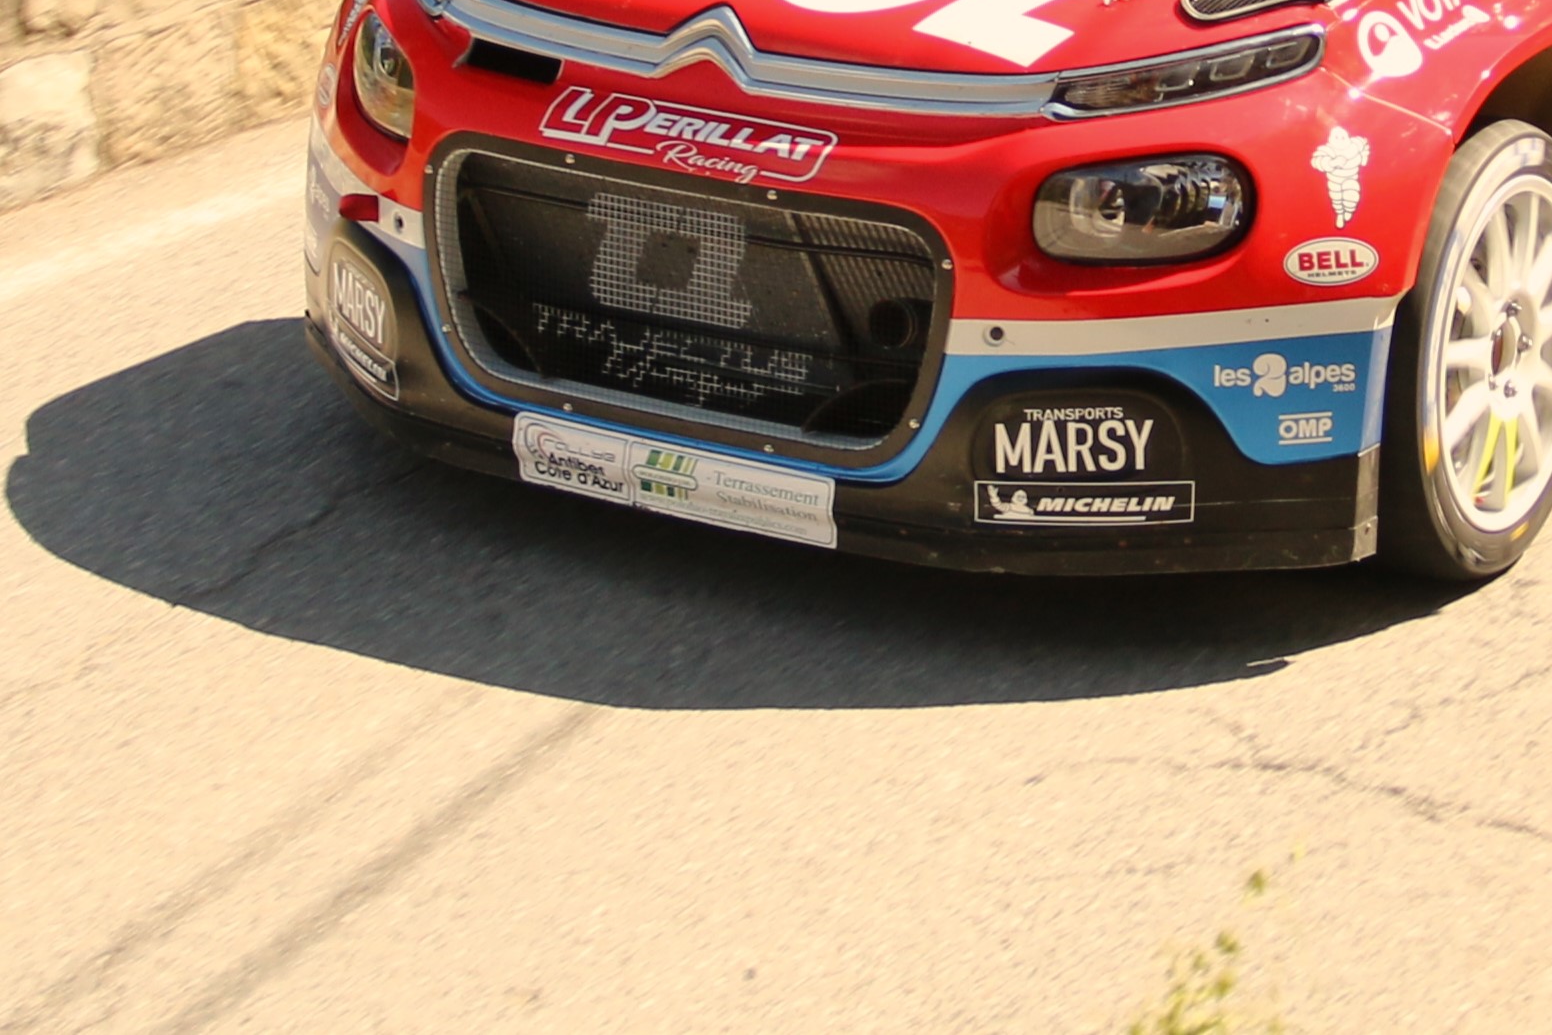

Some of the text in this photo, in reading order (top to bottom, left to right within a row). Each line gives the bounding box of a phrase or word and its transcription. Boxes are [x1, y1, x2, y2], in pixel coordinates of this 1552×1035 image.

[655, 139, 761, 185] Racing
[1297, 248, 1365, 272] BELL
[1306, 269, 1358, 279] HELMETS
[332, 261, 387, 345] MARSY
[1288, 361, 1357, 390] alpes
[1023, 406, 1124, 422] TRANSPORTS
[1278, 417, 1333, 440] OMP
[994, 418, 1154, 474] MARSY
[547, 452, 606, 476] Antibes
[712, 469, 820, 507] Terrassement
[716, 490, 818, 522] Stabilisation
[1035, 496, 1176, 513] MICHELIN
